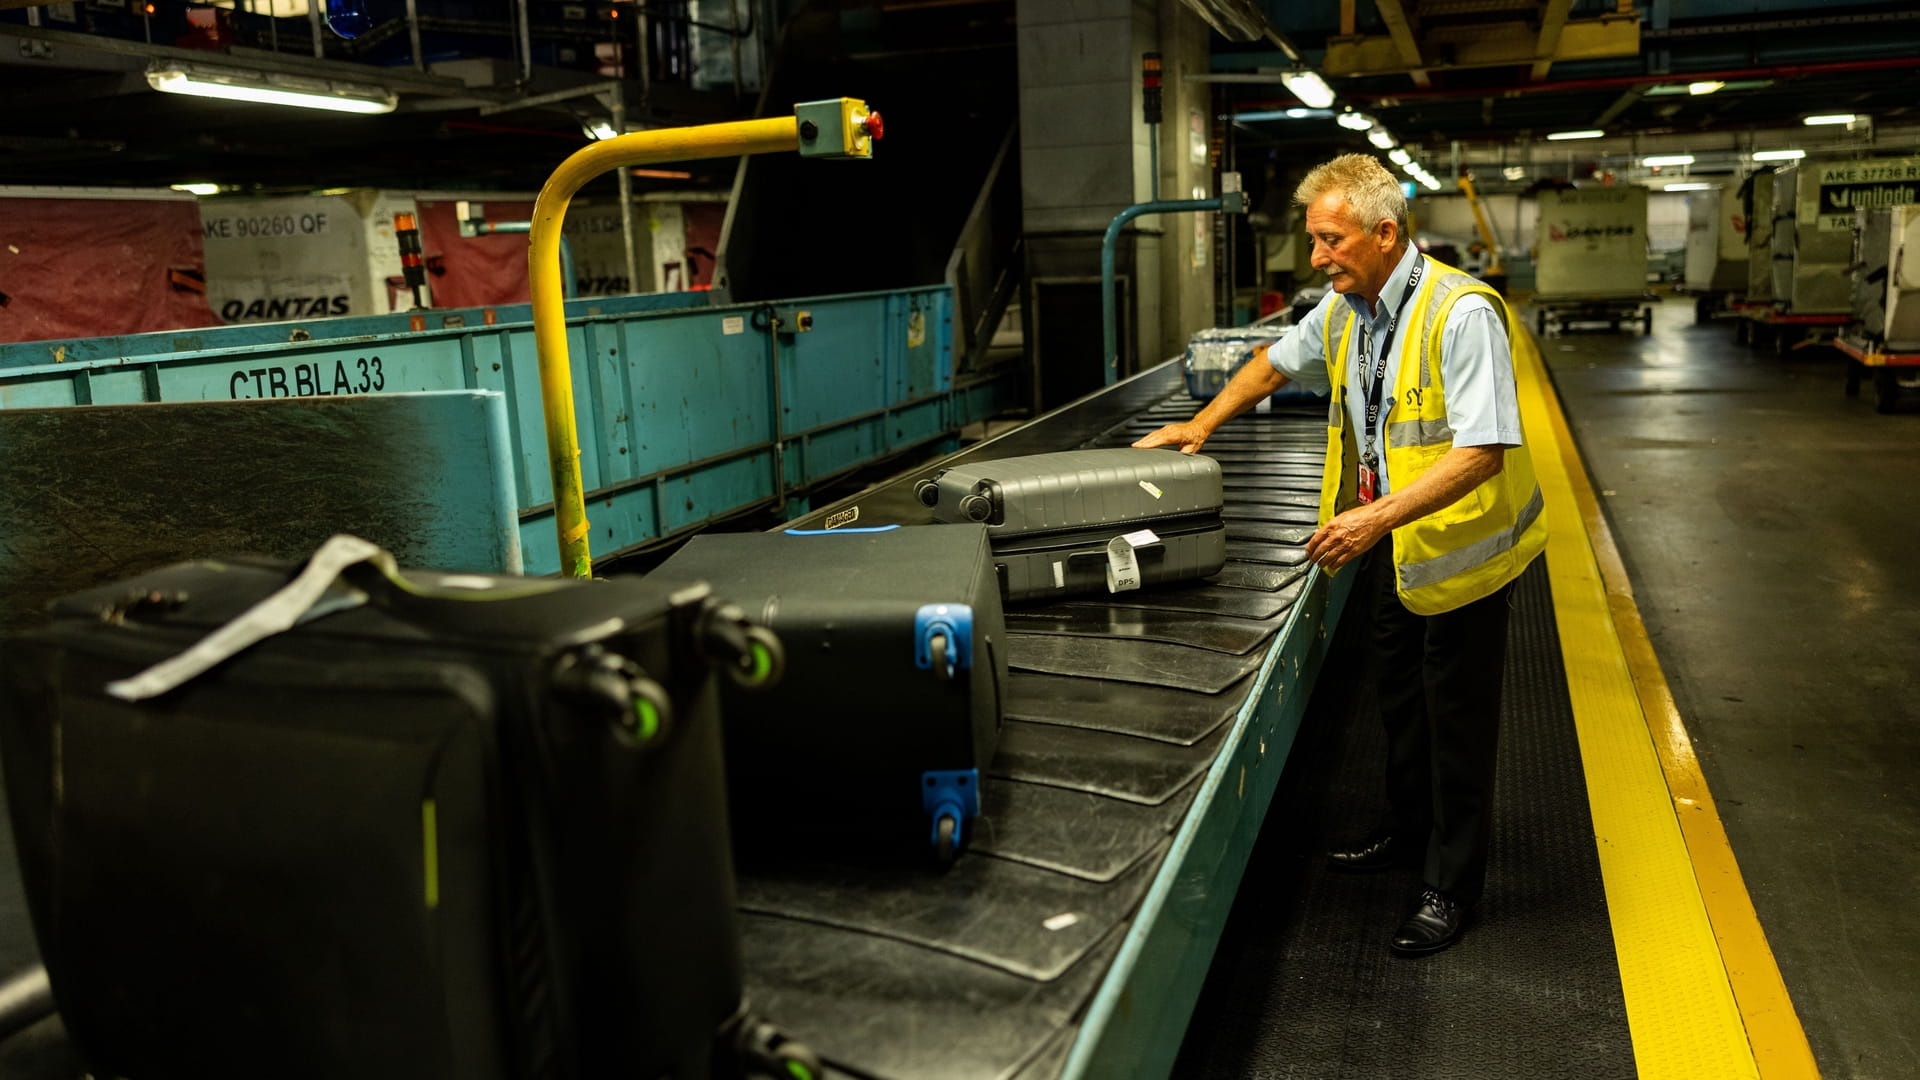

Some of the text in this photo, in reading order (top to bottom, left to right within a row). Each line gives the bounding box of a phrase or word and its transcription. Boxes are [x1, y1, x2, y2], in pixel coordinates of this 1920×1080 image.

[1825, 171, 1856, 181] AKE
[1906, 167, 1920, 177] R
[236, 215, 295, 237] 90260
[301, 213, 327, 234] QF
[1409, 266, 1422, 286] SYD
[221, 295, 350, 321] QANTAS
[1376, 359, 1385, 378] SYD
[1368, 404, 1378, 422] SYD
[1118, 577, 1134, 586] DPS
